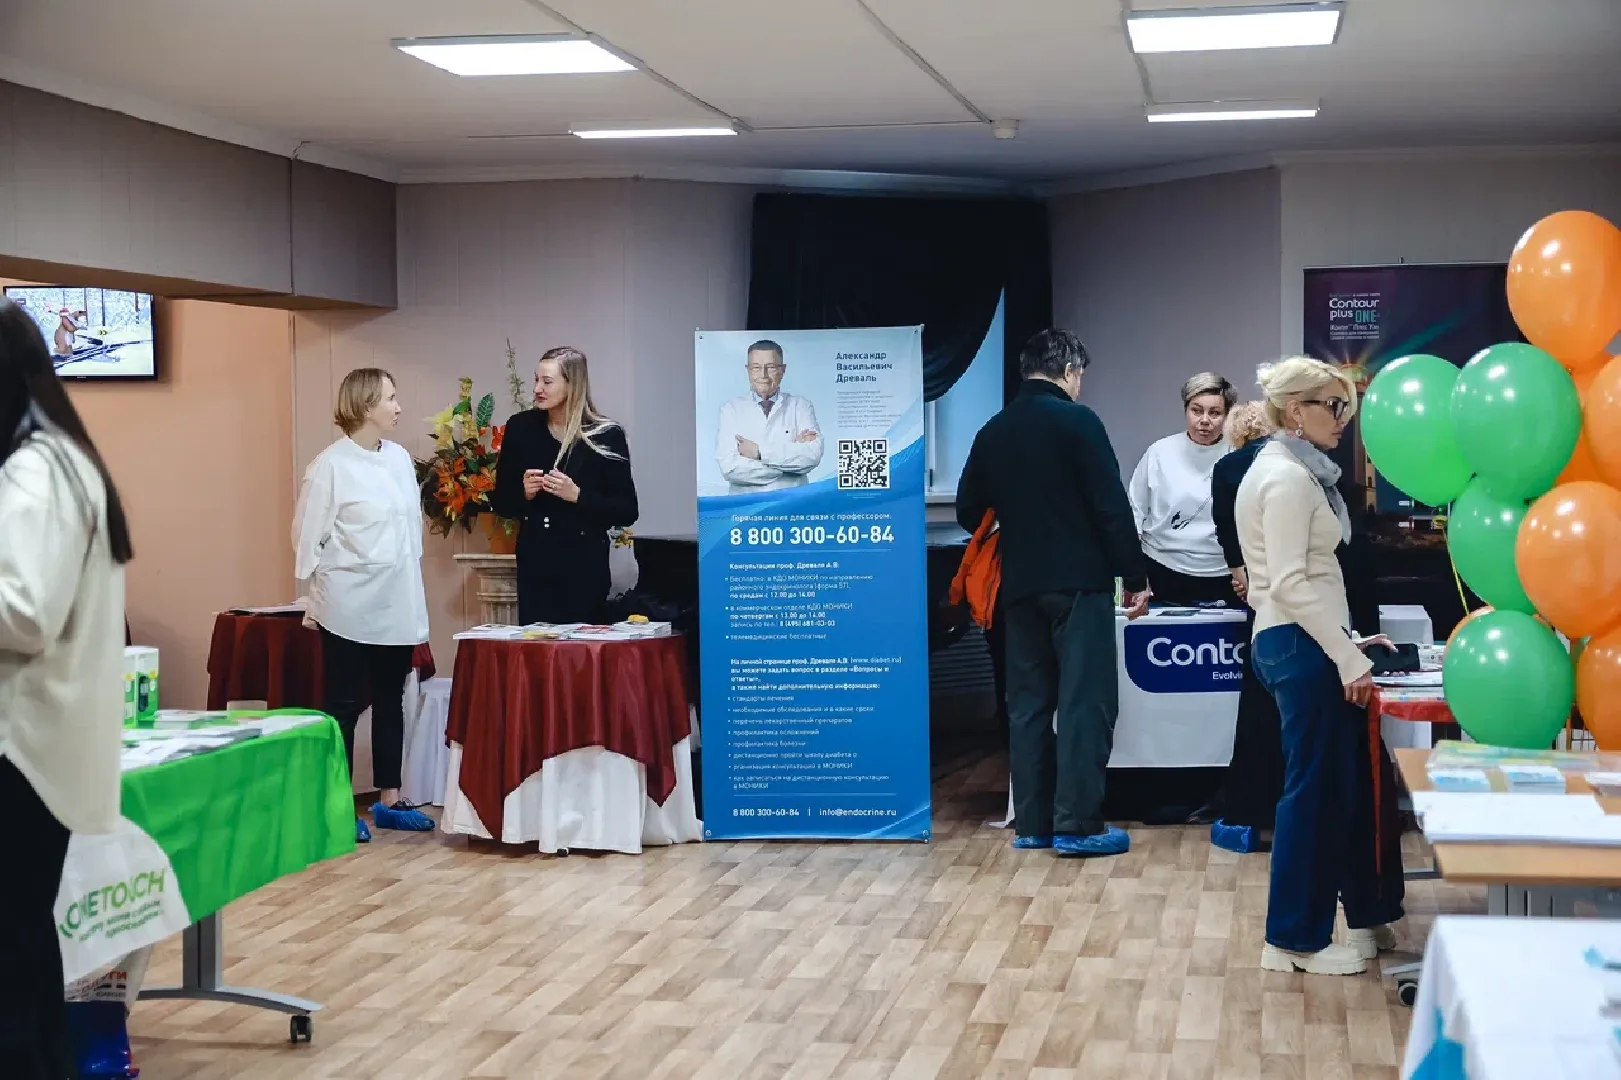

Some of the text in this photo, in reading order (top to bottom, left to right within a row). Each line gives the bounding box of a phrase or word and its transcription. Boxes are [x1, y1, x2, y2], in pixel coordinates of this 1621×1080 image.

[1329, 298, 1380, 308] Contour
[1329, 309, 1377, 323] plus ONE
[835, 352, 887, 361] Александр
[836, 362, 894, 371] Васильевич
[835, 373, 877, 384] Древаль
[732, 514, 762, 523] Горячая
[790, 514, 804, 522] для
[805, 513, 829, 521] связи
[837, 512, 892, 521] профессором:
[730, 525, 895, 545] 8 800 300-60-84
[777, 562, 795, 570] проф.
[758, 683, 777, 691] найти
[778, 683, 834, 691] дополнительную
[733, 808, 897, 817] 8 800 300-60-84 info@endocrine.ru
